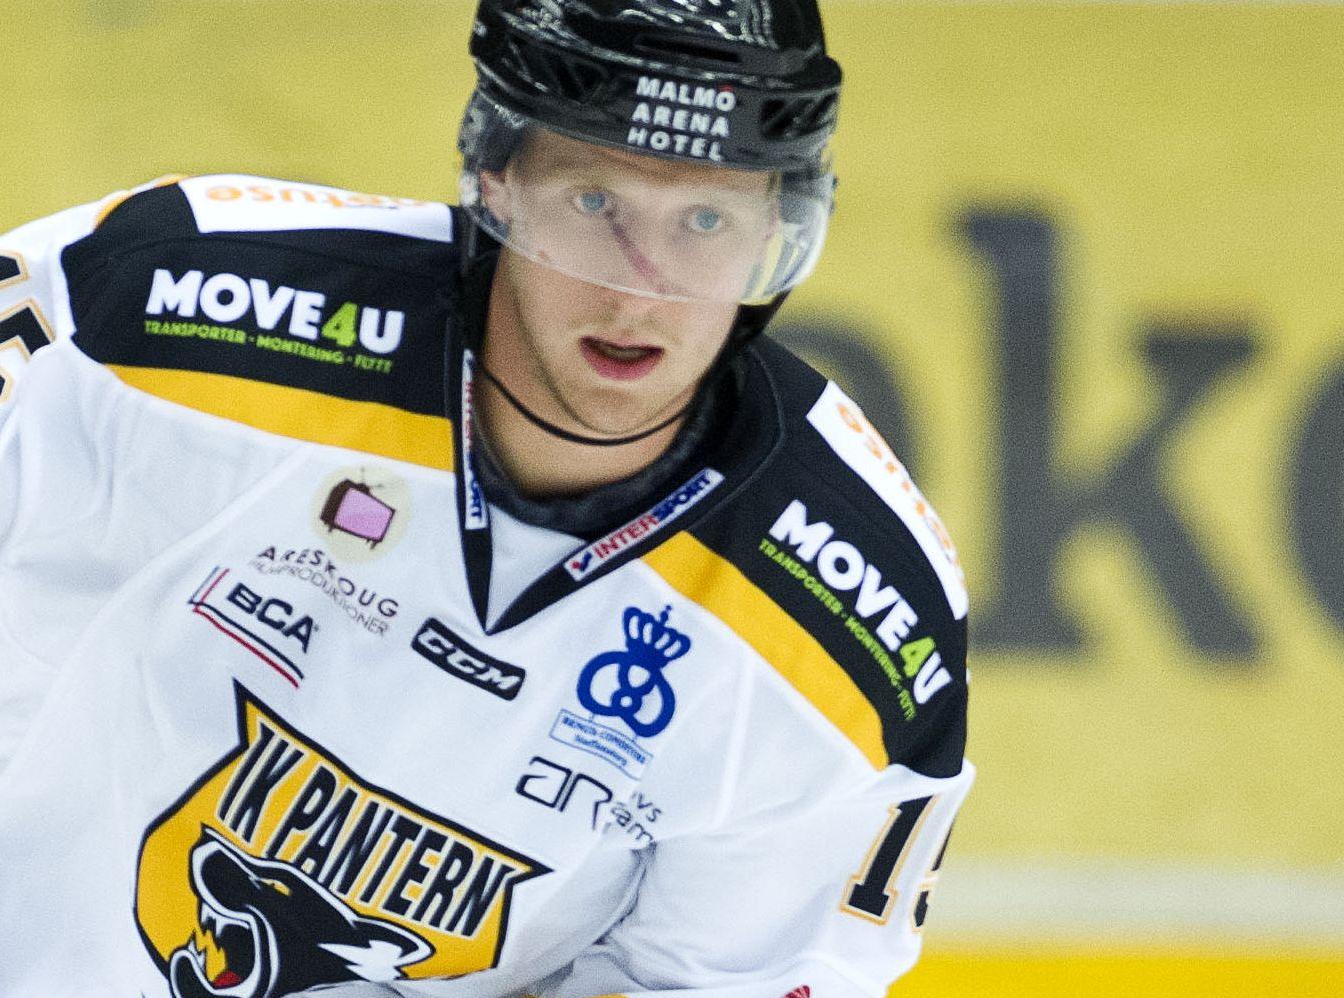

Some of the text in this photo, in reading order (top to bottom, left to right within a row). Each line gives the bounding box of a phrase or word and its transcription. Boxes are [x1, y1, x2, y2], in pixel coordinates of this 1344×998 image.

[627, 126, 722, 162] HOTEL
[631, 102, 730, 138] ARENA
[145, 268, 406, 355] MOVE4U
[593, 474, 711, 559] INTERSPORT
[226, 582, 315, 654] BCA
[768, 498, 953, 705] MOVE4U
[417, 627, 522, 690] CCM
[217, 720, 517, 939] IK PANTERN
